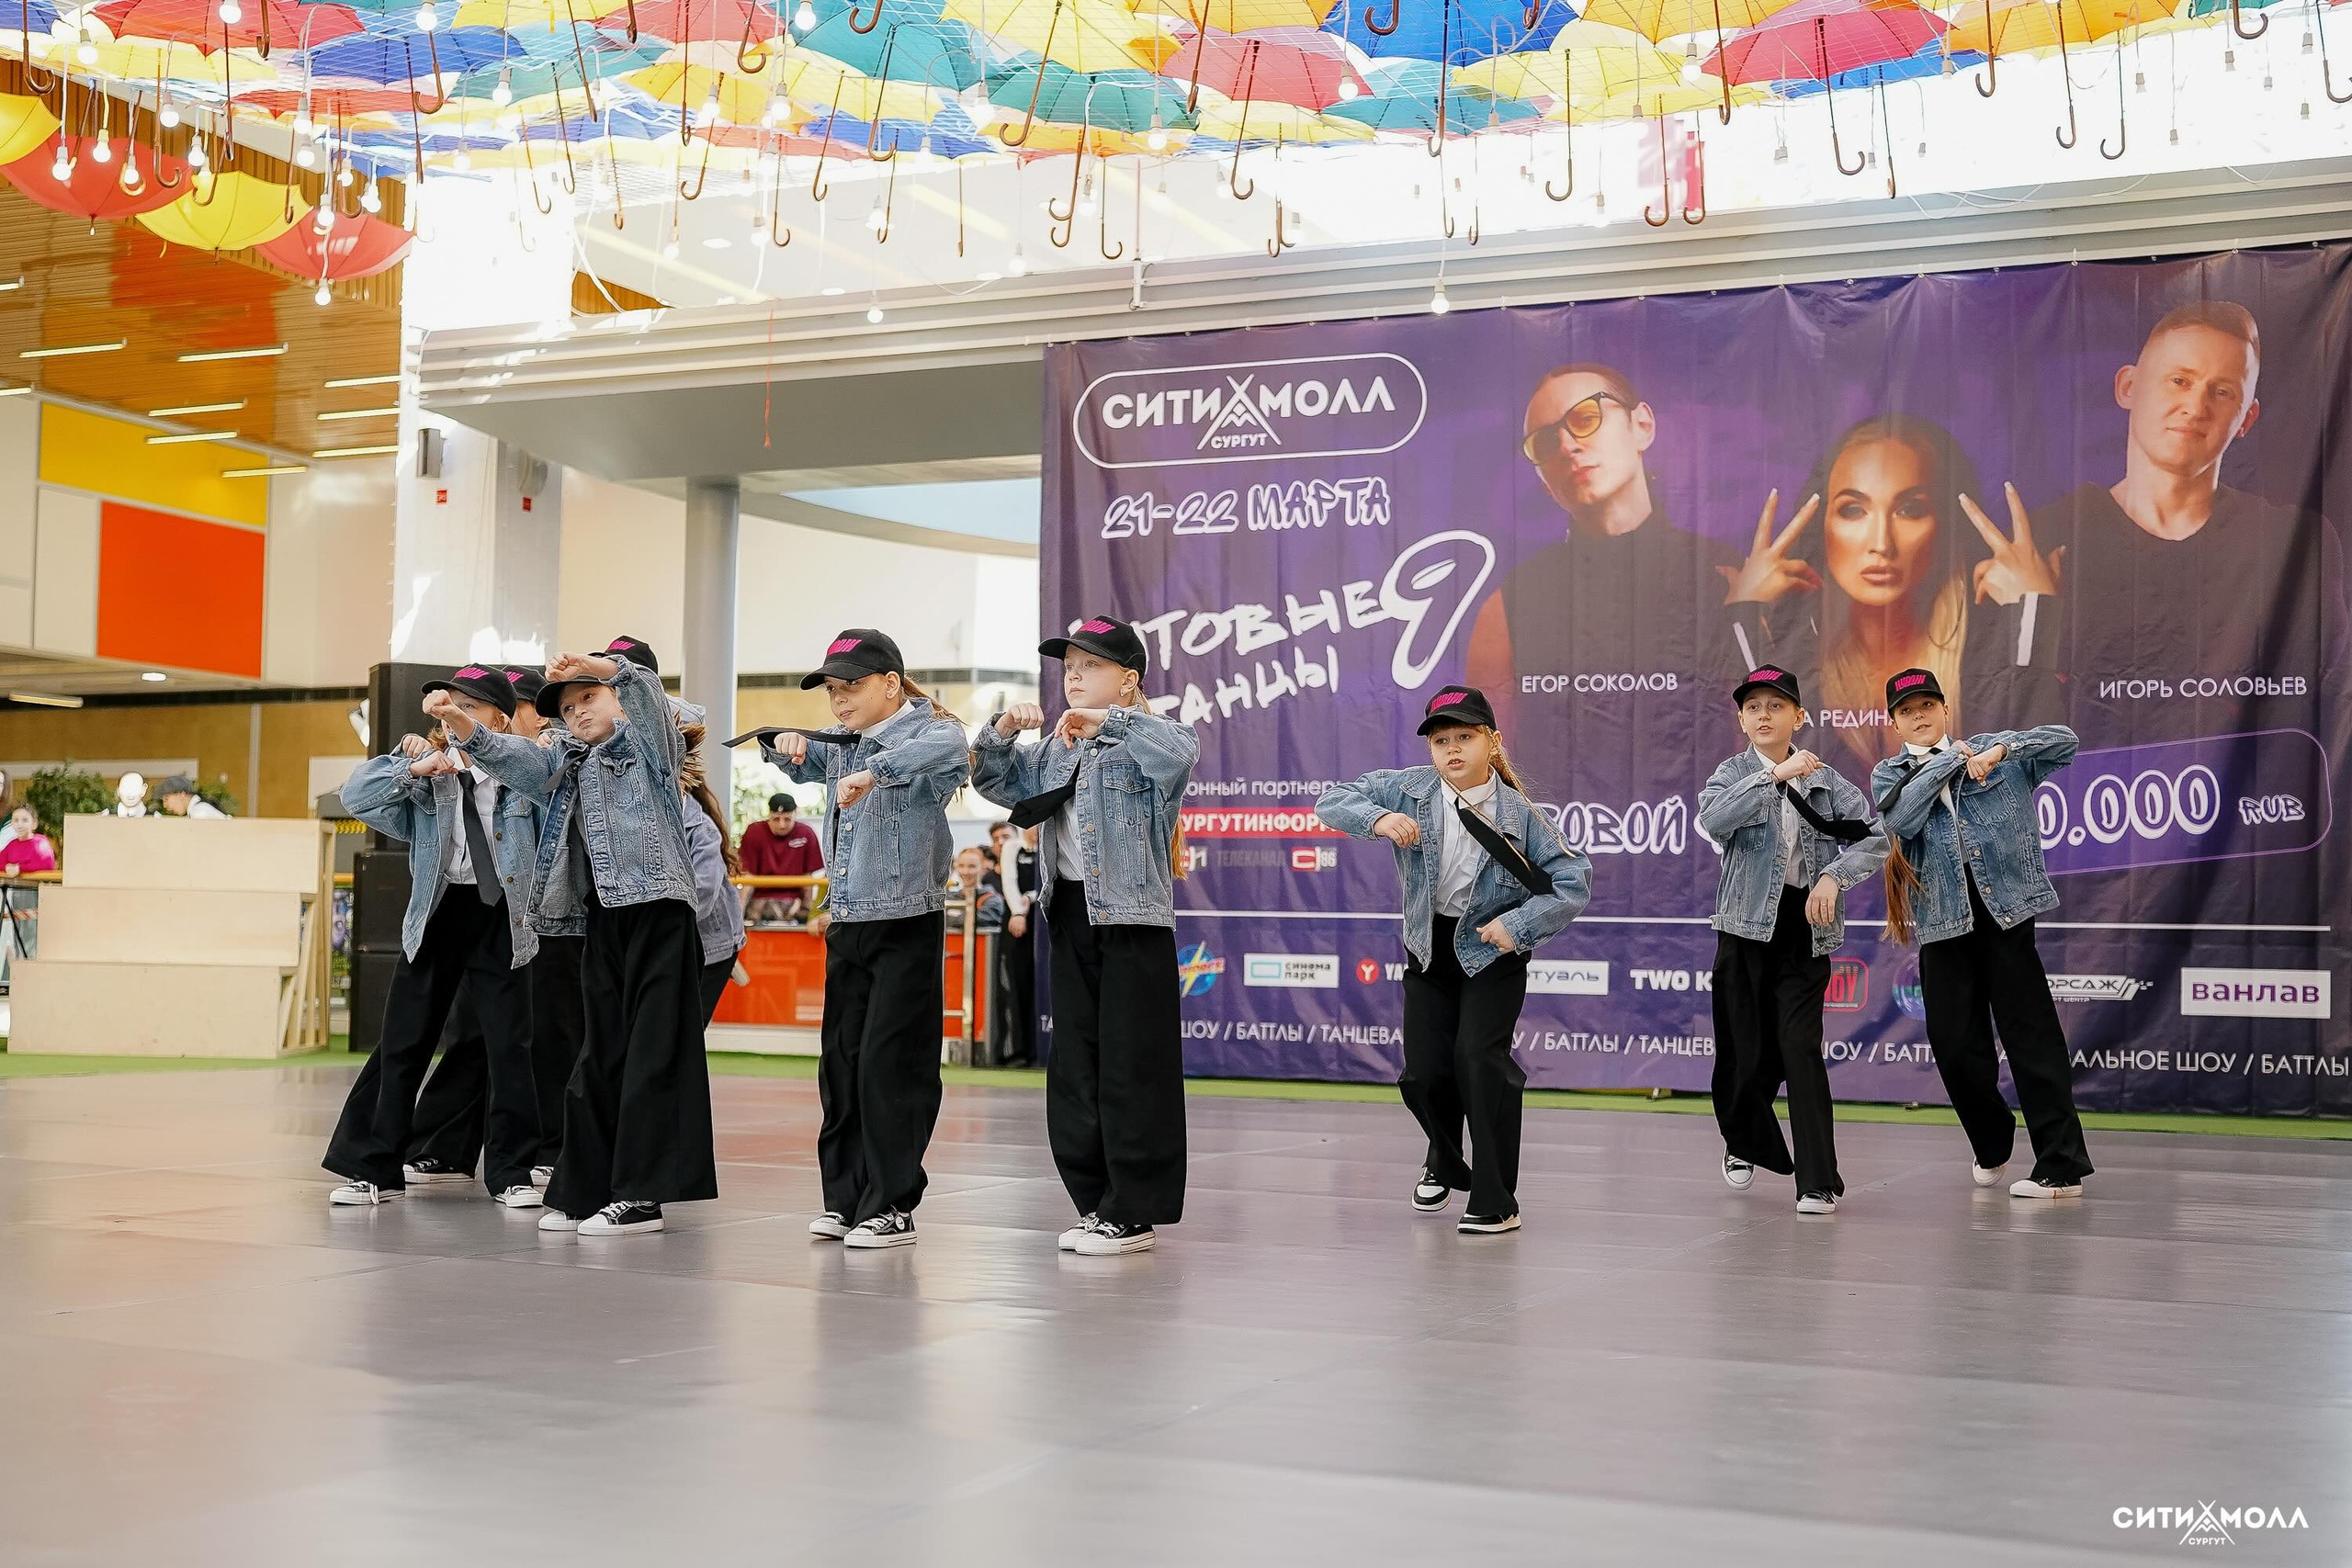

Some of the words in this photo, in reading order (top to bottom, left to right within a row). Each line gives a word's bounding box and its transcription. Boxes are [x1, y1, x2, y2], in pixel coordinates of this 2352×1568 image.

[1211, 434, 1267, 448] СУРГУТ
[1102, 491, 1239, 538] 21-22
[1248, 477, 1392, 531] МАРТА
[1521, 674, 1570, 693] ЕГОР
[1574, 672, 1679, 692] СОКОЛОВ
[2099, 680, 2174, 699] ИГОРЬ
[2178, 676, 2308, 697] СОЛОВЬЕВ
[1820, 708, 1893, 728] РЕДИН
[2238, 794, 2306, 825] RUB
[1182, 812, 1336, 832] УРГУТИНФОР
[1284, 972, 1316, 982] парк
[1285, 963, 1330, 971] синема
[1527, 970, 1600, 984] туаль
[1630, 968, 1690, 991] TWO
[2192, 982, 2321, 1004] ванлав
[1237, 1021, 1303, 1042] БАТТЛЫ
[1544, 1032, 1619, 1054] БАТТЛЫ
[1883, 1042, 1937, 1064] БАТТ
[2068, 1049, 2169, 1071] АЛЬНОЕ
[2177, 1052, 2236, 1073] ШОУ
[2261, 1054, 2350, 1077] БАТТЛЫ
